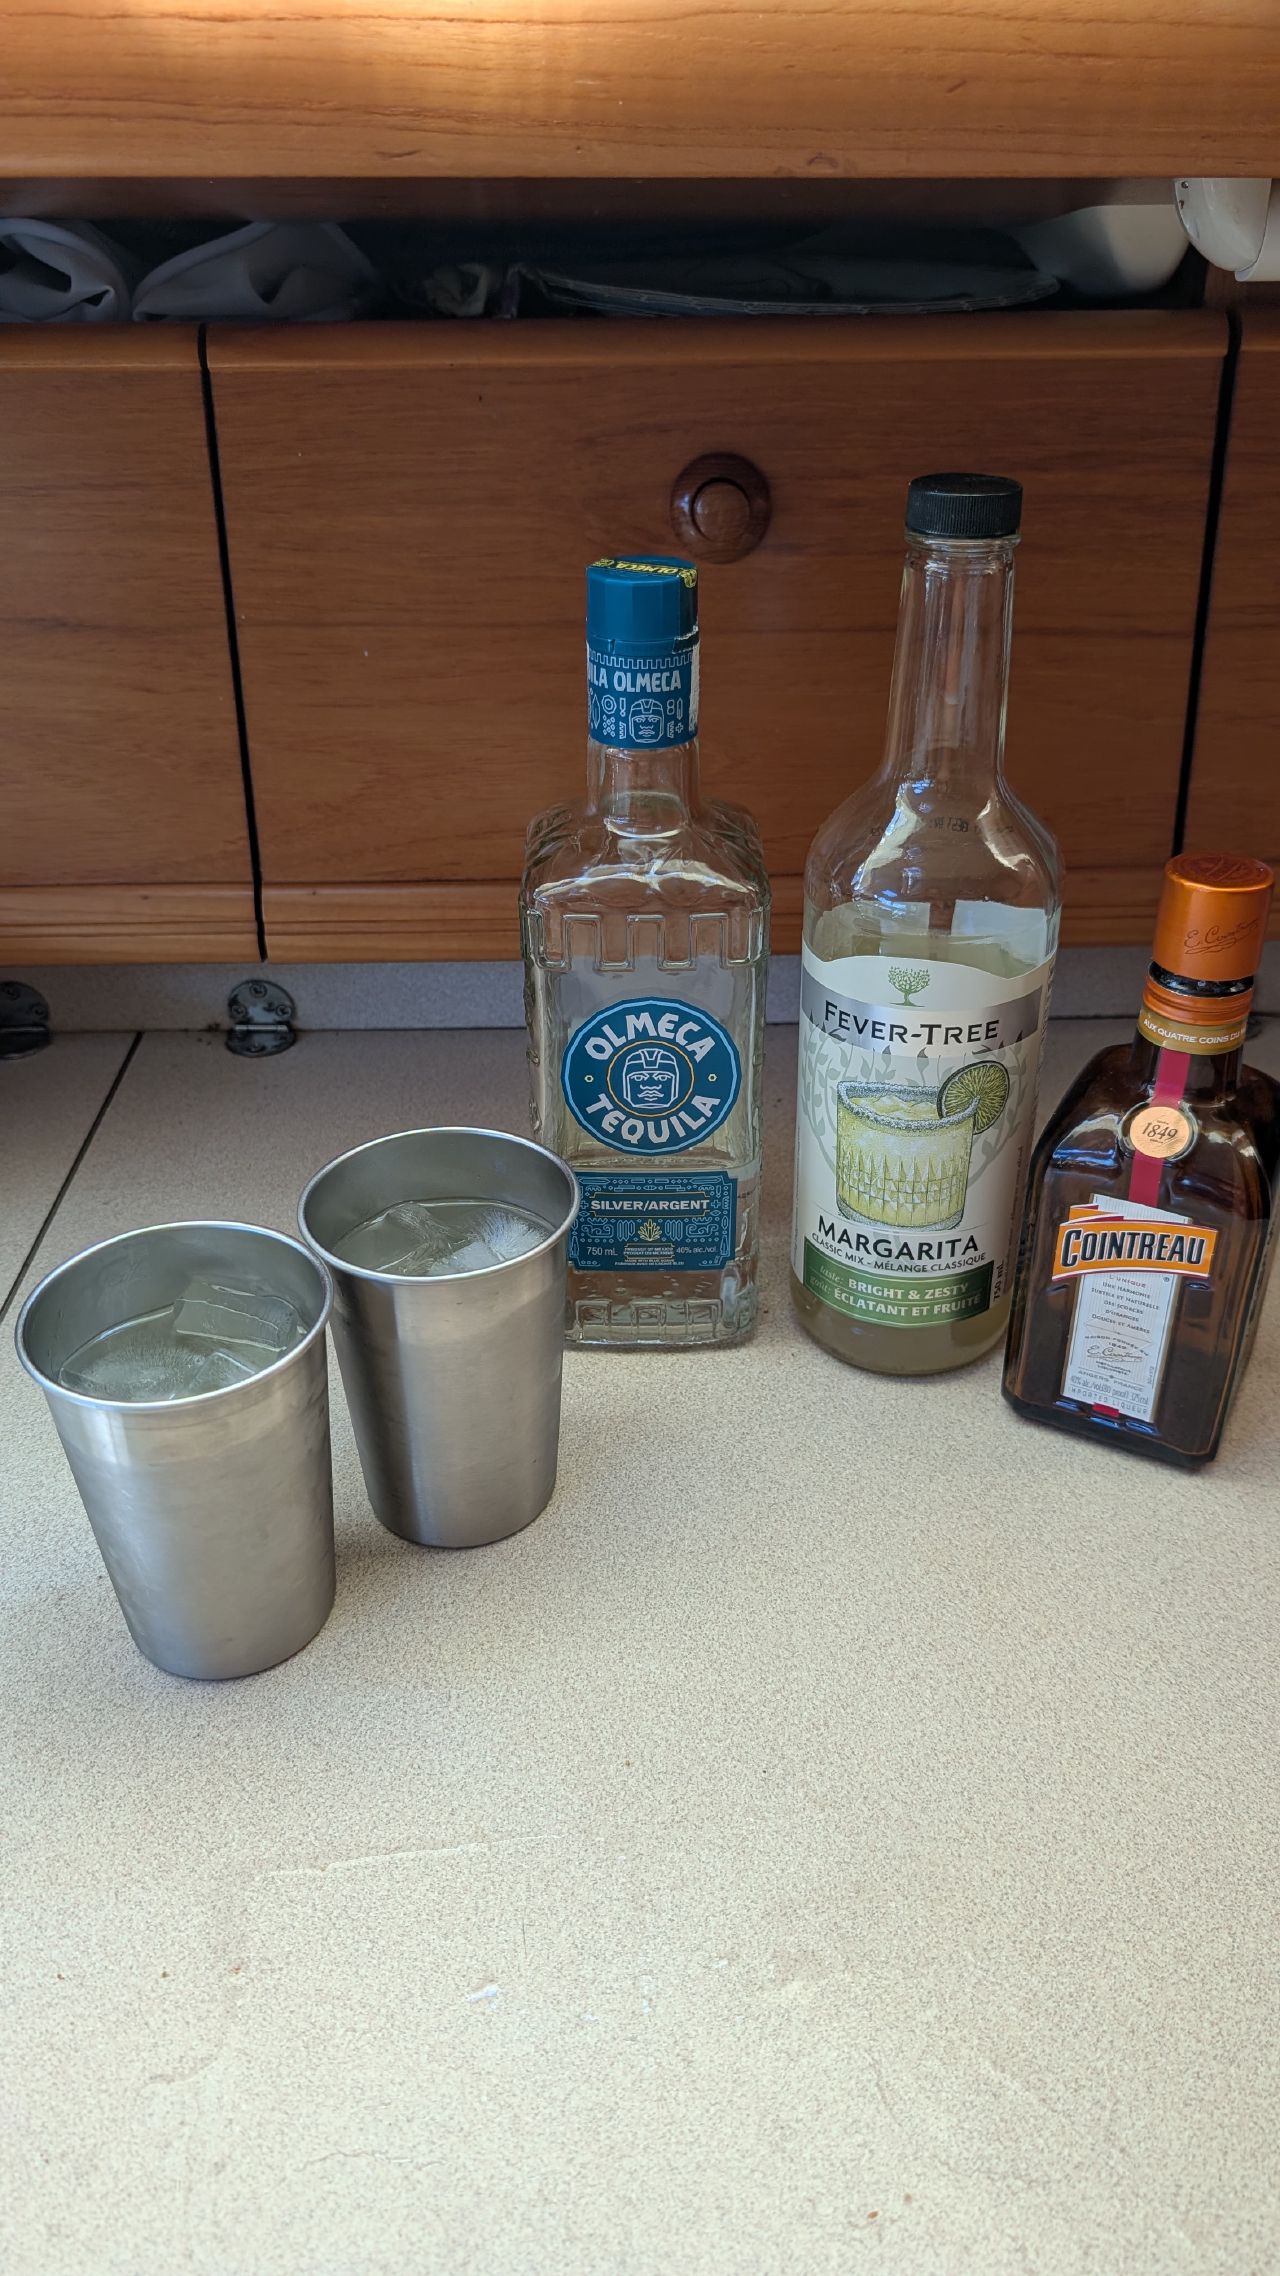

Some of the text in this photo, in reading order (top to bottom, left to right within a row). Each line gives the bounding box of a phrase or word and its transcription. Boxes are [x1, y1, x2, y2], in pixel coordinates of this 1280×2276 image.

[613, 670, 681, 692] OLMECA
[824, 1000, 1000, 1045] FEVER-TREE
[1143, 1019, 1157, 1033] AUX
[1157, 1027, 1197, 1043] QUATRE
[1198, 1035, 1229, 1044] COINS
[584, 1012, 716, 1064] OLMECA
[585, 1093, 721, 1144] TEQUILA
[1142, 1122, 1178, 1142] 1849
[590, 1200, 710, 1211] SILVER/ARGENT
[587, 1247, 602, 1256] 750
[811, 1232, 843, 1257] CLASSIC
[845, 1251, 864, 1265] MIX
[873, 1260, 928, 1273] MÉLANGE
[930, 1252, 986, 1273] CLASSIQUE
[818, 1215, 978, 1261] MARGARITA
[1060, 1228, 1207, 1268] COINTREAU
[834, 1287, 908, 1317] ÉCLATANT
[911, 1306, 928, 1316] ET
[848, 1278, 905, 1299] BRIGHT
[908, 1290, 920, 1300] &
[925, 1282, 969, 1300] ZESTY
